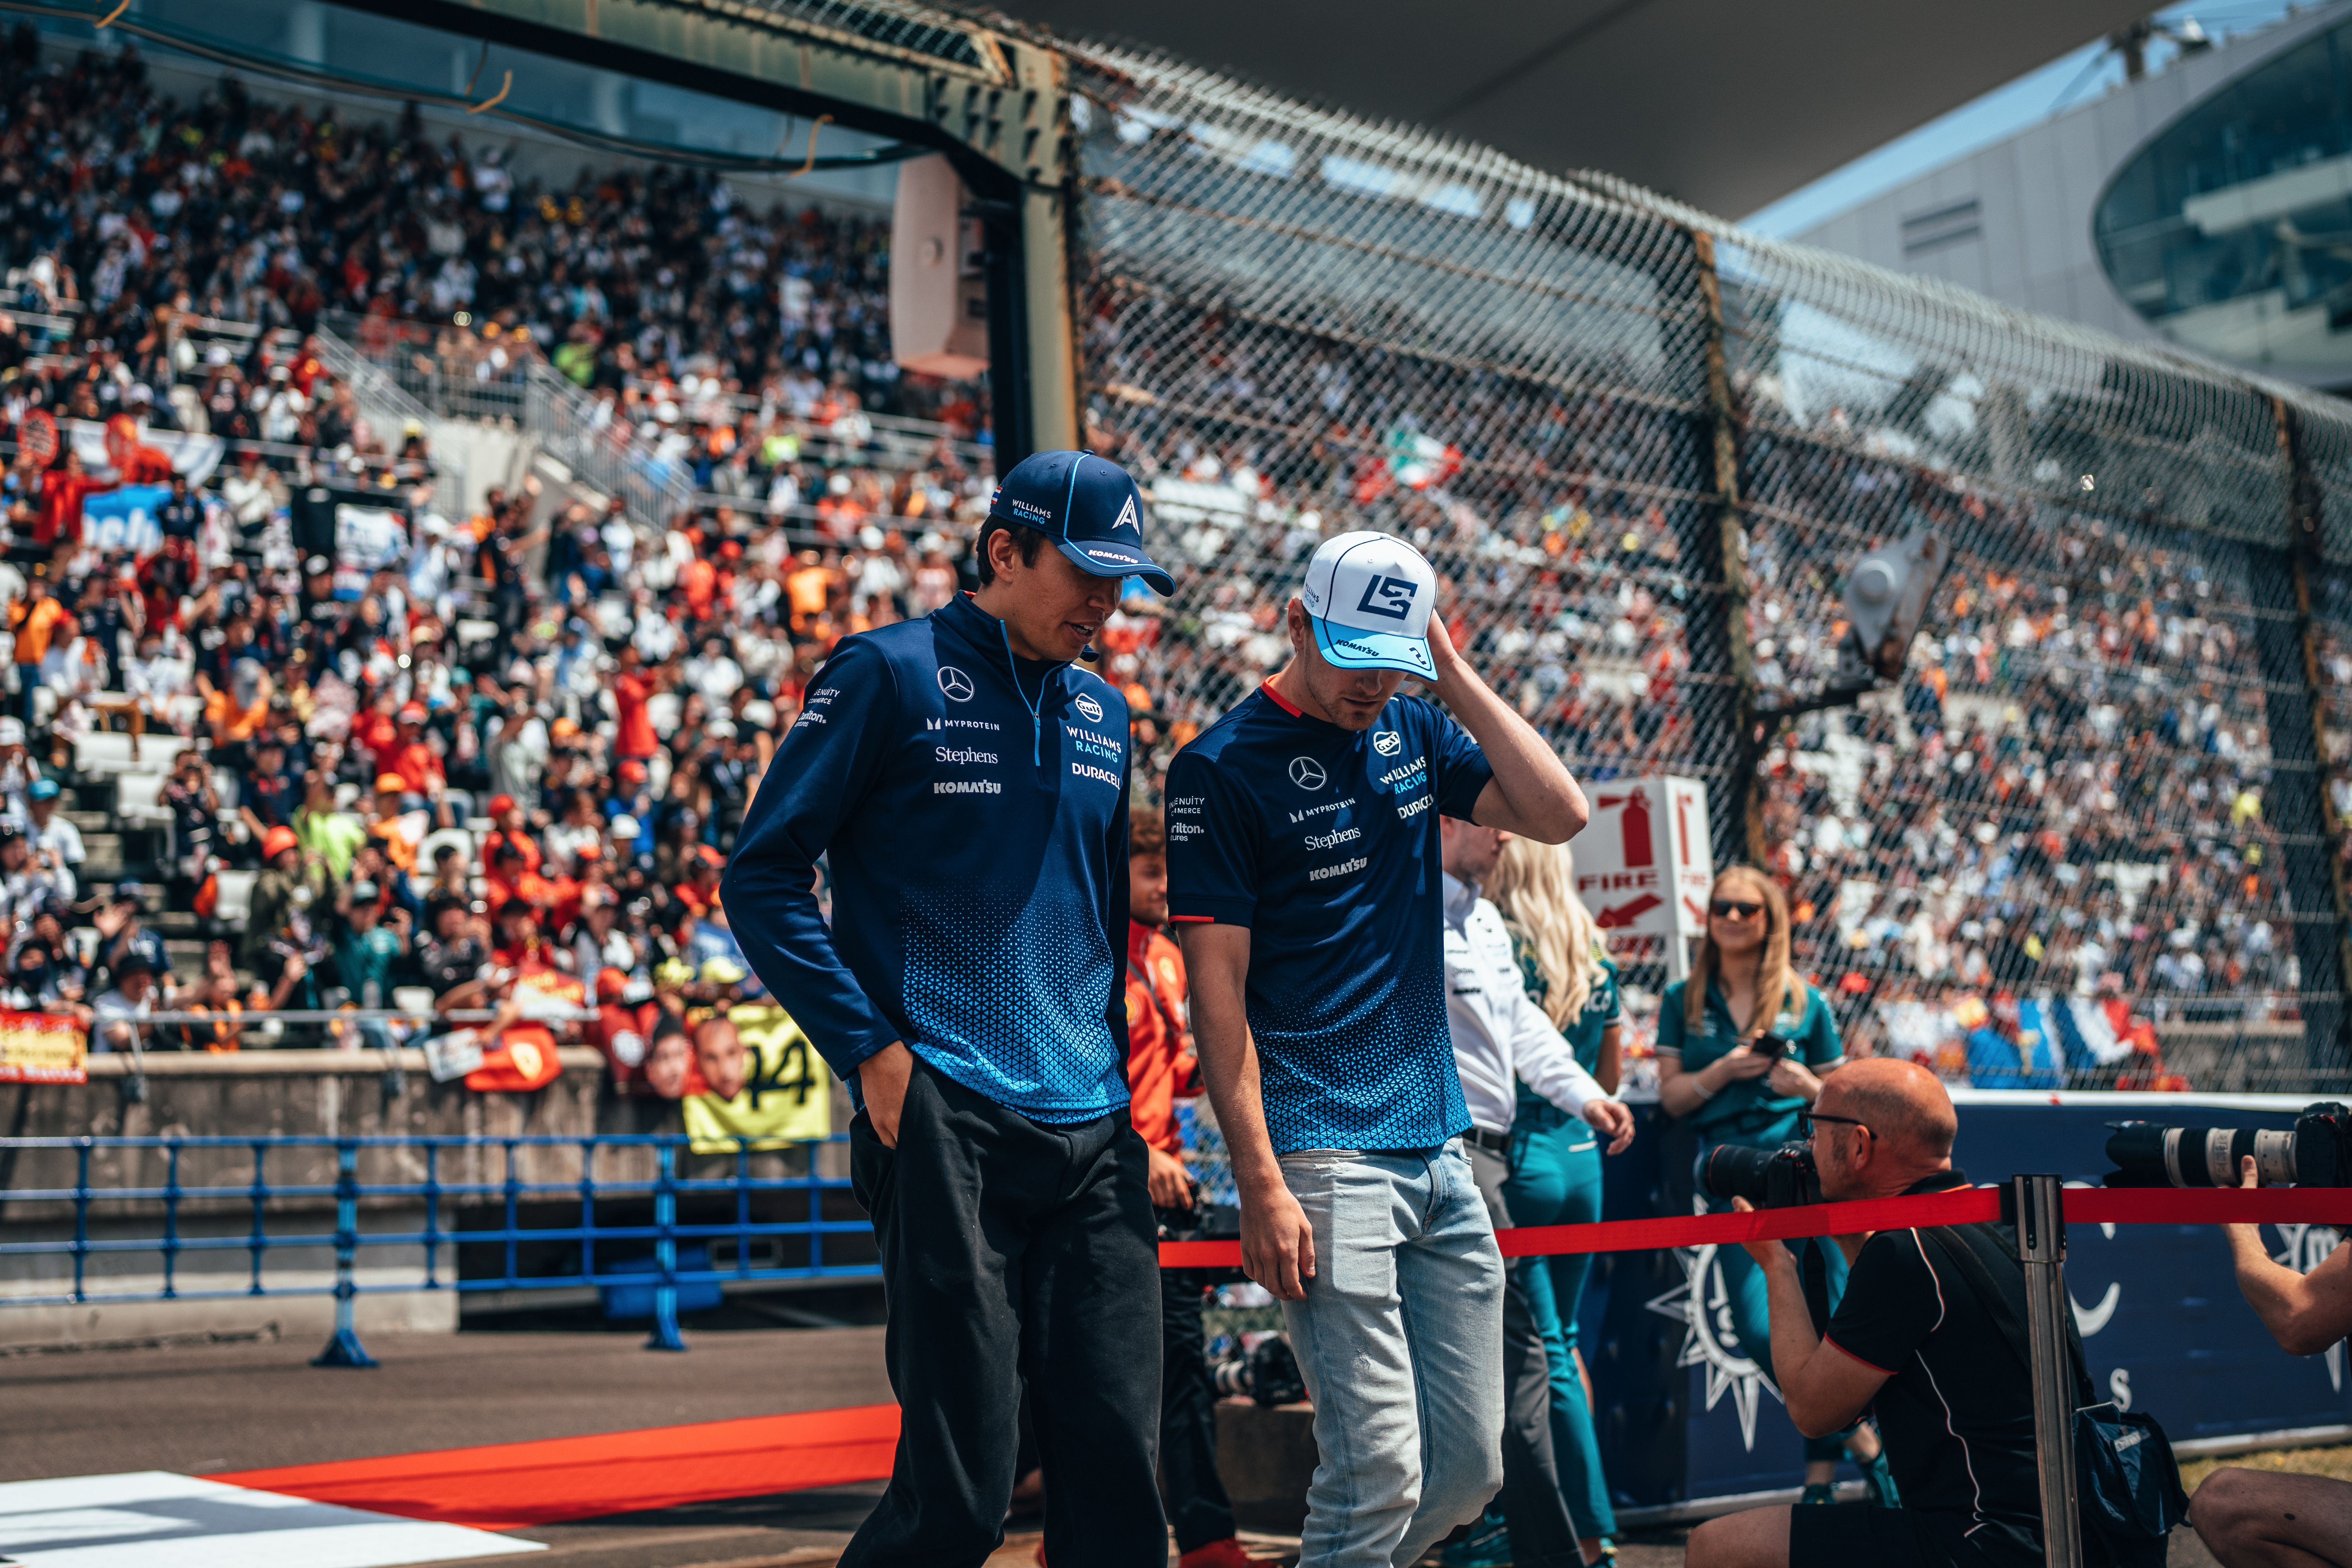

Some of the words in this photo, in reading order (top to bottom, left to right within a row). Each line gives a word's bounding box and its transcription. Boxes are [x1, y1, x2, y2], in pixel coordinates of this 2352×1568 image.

[1012, 499, 1051, 519] WILLIAMS
[1013, 508, 1045, 524] RACING
[1088, 549, 1138, 564] KOMATSU
[1305, 591, 1314, 608] ACING
[1335, 639, 1380, 657] KOMATSU
[1077, 701, 1100, 715] Gulf
[945, 719, 1000, 731] MYPROTEIN
[1066, 725, 1121, 753] WILLIAMS
[1377, 734, 1399, 751] Gulf
[935, 747, 998, 765] Stephens
[1076, 740, 1117, 763] RACING
[1072, 763, 1120, 790] DURACELL
[1379, 756, 1427, 784] WILLIAMS
[934, 779, 1001, 794] KOMATSU
[1394, 771, 1427, 794] RACING
[1171, 808, 1201, 816] CMERCE
[1306, 798, 1356, 817] MYPROTEIN
[1171, 822, 1204, 834] rilton.
[1305, 827, 1361, 851] Stephens
[1309, 857, 1368, 882] KOMATSU
[1577, 870, 1658, 892] FIRE
